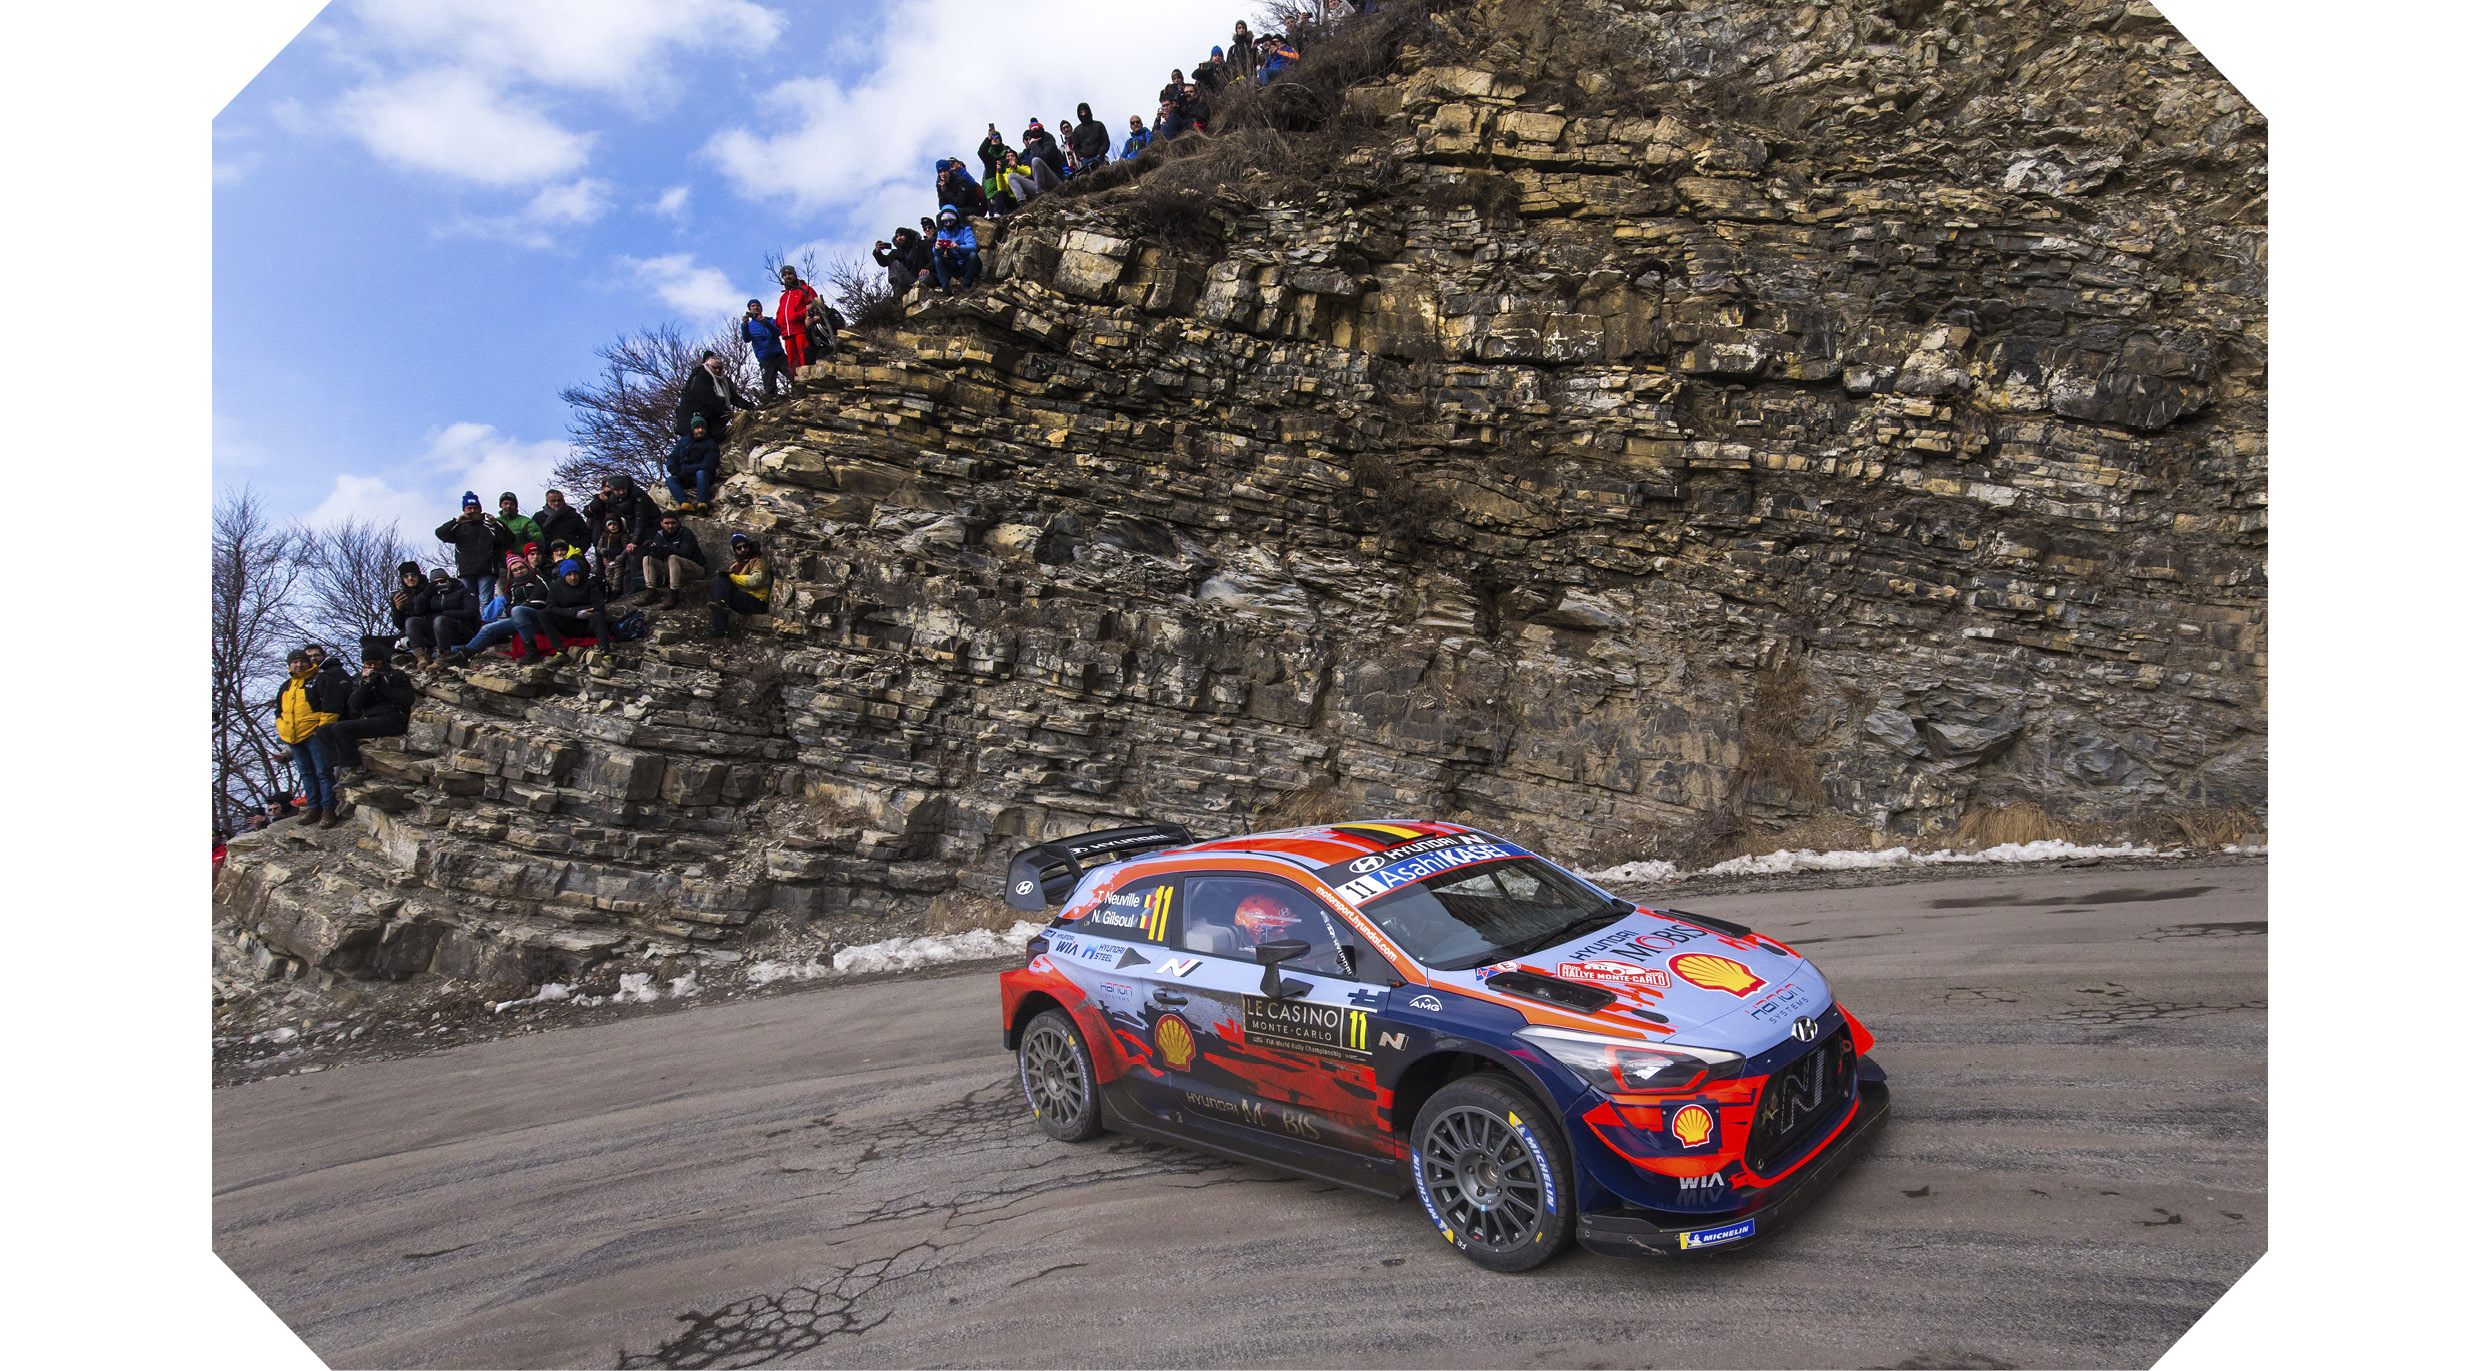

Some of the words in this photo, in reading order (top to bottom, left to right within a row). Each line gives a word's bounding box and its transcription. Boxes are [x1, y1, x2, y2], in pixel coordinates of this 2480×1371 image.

[1384, 837, 1458, 860] HYUNDAI
[1345, 881, 1377, 899] 11
[1379, 845, 1510, 888] AsahiKASEI
[1104, 891, 1140, 908] Neuville
[1092, 910, 1100, 923] N.
[1102, 911, 1135, 928] Gilsoul
[1148, 885, 1174, 942] 11
[1316, 886, 1397, 962] motorsport.hyundai.com
[1098, 944, 1125, 954] HYUNDAI
[1569, 930, 1639, 961] HYUNDAI
[1609, 924, 1708, 962] MOBIS
[1094, 952, 1112, 962] STEEL
[1562, 968, 1595, 979] RALLYE
[1597, 973, 1666, 986] MONTE-CARLO
[1247, 999, 1264, 1017] LE
[1267, 1002, 1338, 1028] CASINO
[1410, 1000, 1440, 1012] AMG
[1769, 997, 1809, 1024] SYSTEMS
[1350, 1010, 1368, 1050] 11
[1186, 1091, 1239, 1115] HYUNDAI
[1525, 1136, 1554, 1208] MICHELIN
[1679, 1171, 1725, 1190] WIA
[1412, 1154, 1438, 1220] MICHELIN
[1703, 1225, 1749, 1242] MICHELIN
